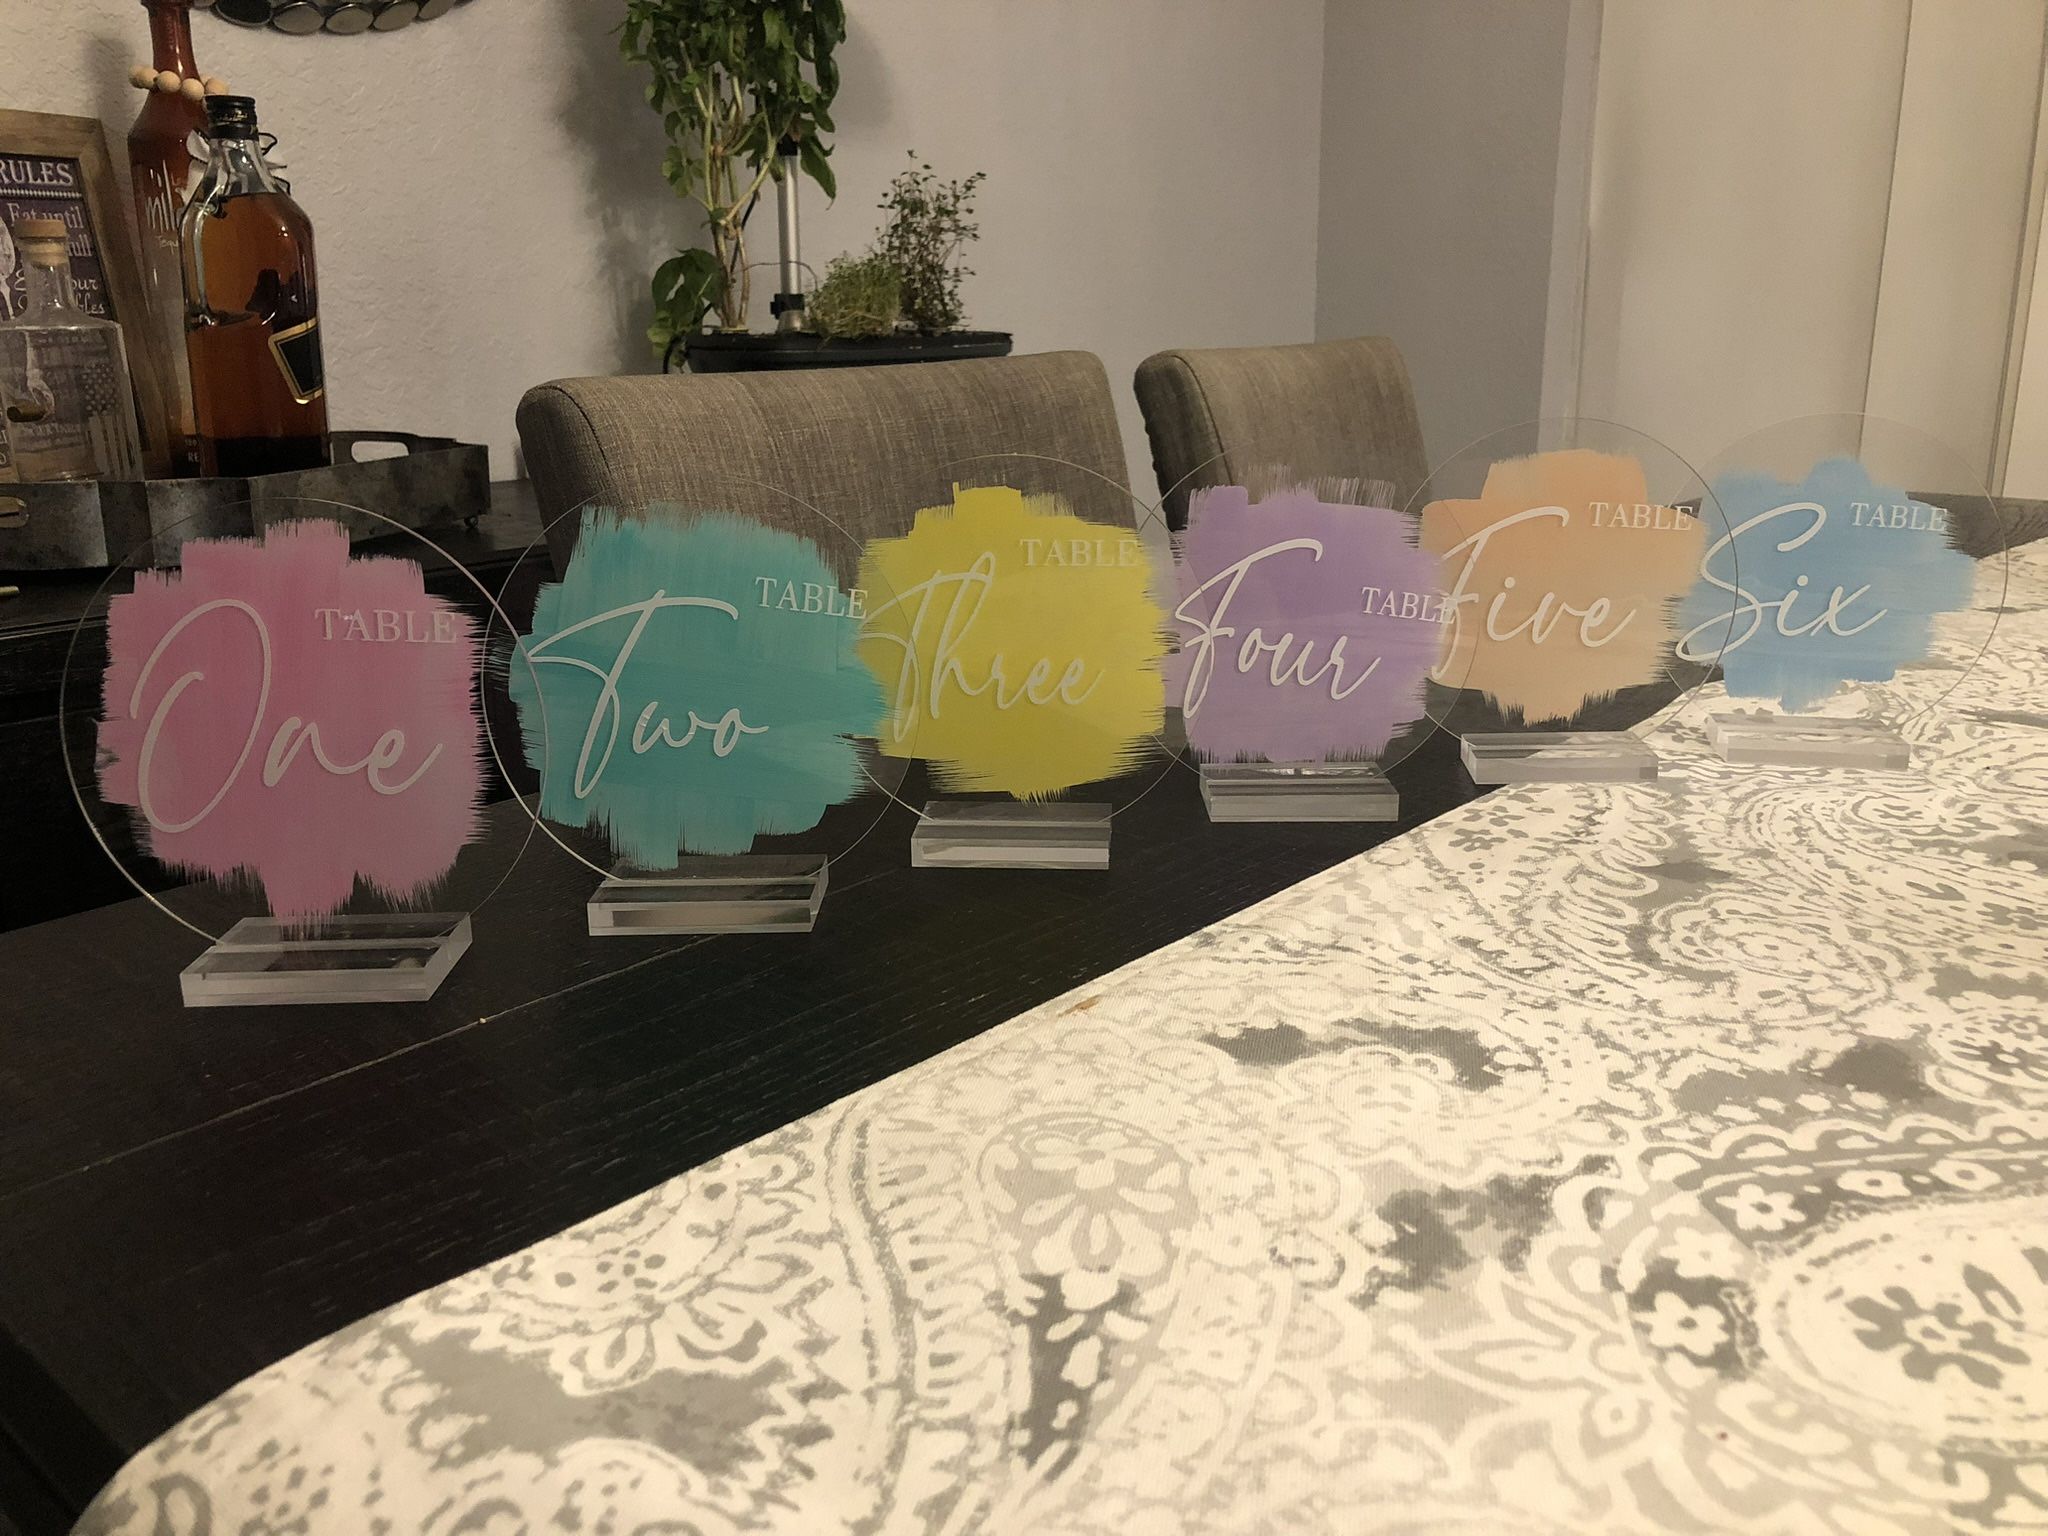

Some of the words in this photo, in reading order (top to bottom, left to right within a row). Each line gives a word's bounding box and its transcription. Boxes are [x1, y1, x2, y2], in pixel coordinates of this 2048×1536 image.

[1020, 538, 1138, 567] TABLE
[1589, 502, 1693, 531] TABLE
[1850, 502, 1947, 531] TABLE
[314, 608, 457, 643] TABLE
[754, 576, 868, 619] TABLE
[1175, 538, 1382, 718] Four
[1361, 586, 1456, 625] TABLE
[1432, 506, 1637, 680] Five
[1675, 502, 1888, 661] Six
[528, 589, 769, 799] Two
[860, 551, 1104, 743] Three
[131, 598, 443, 833] One
